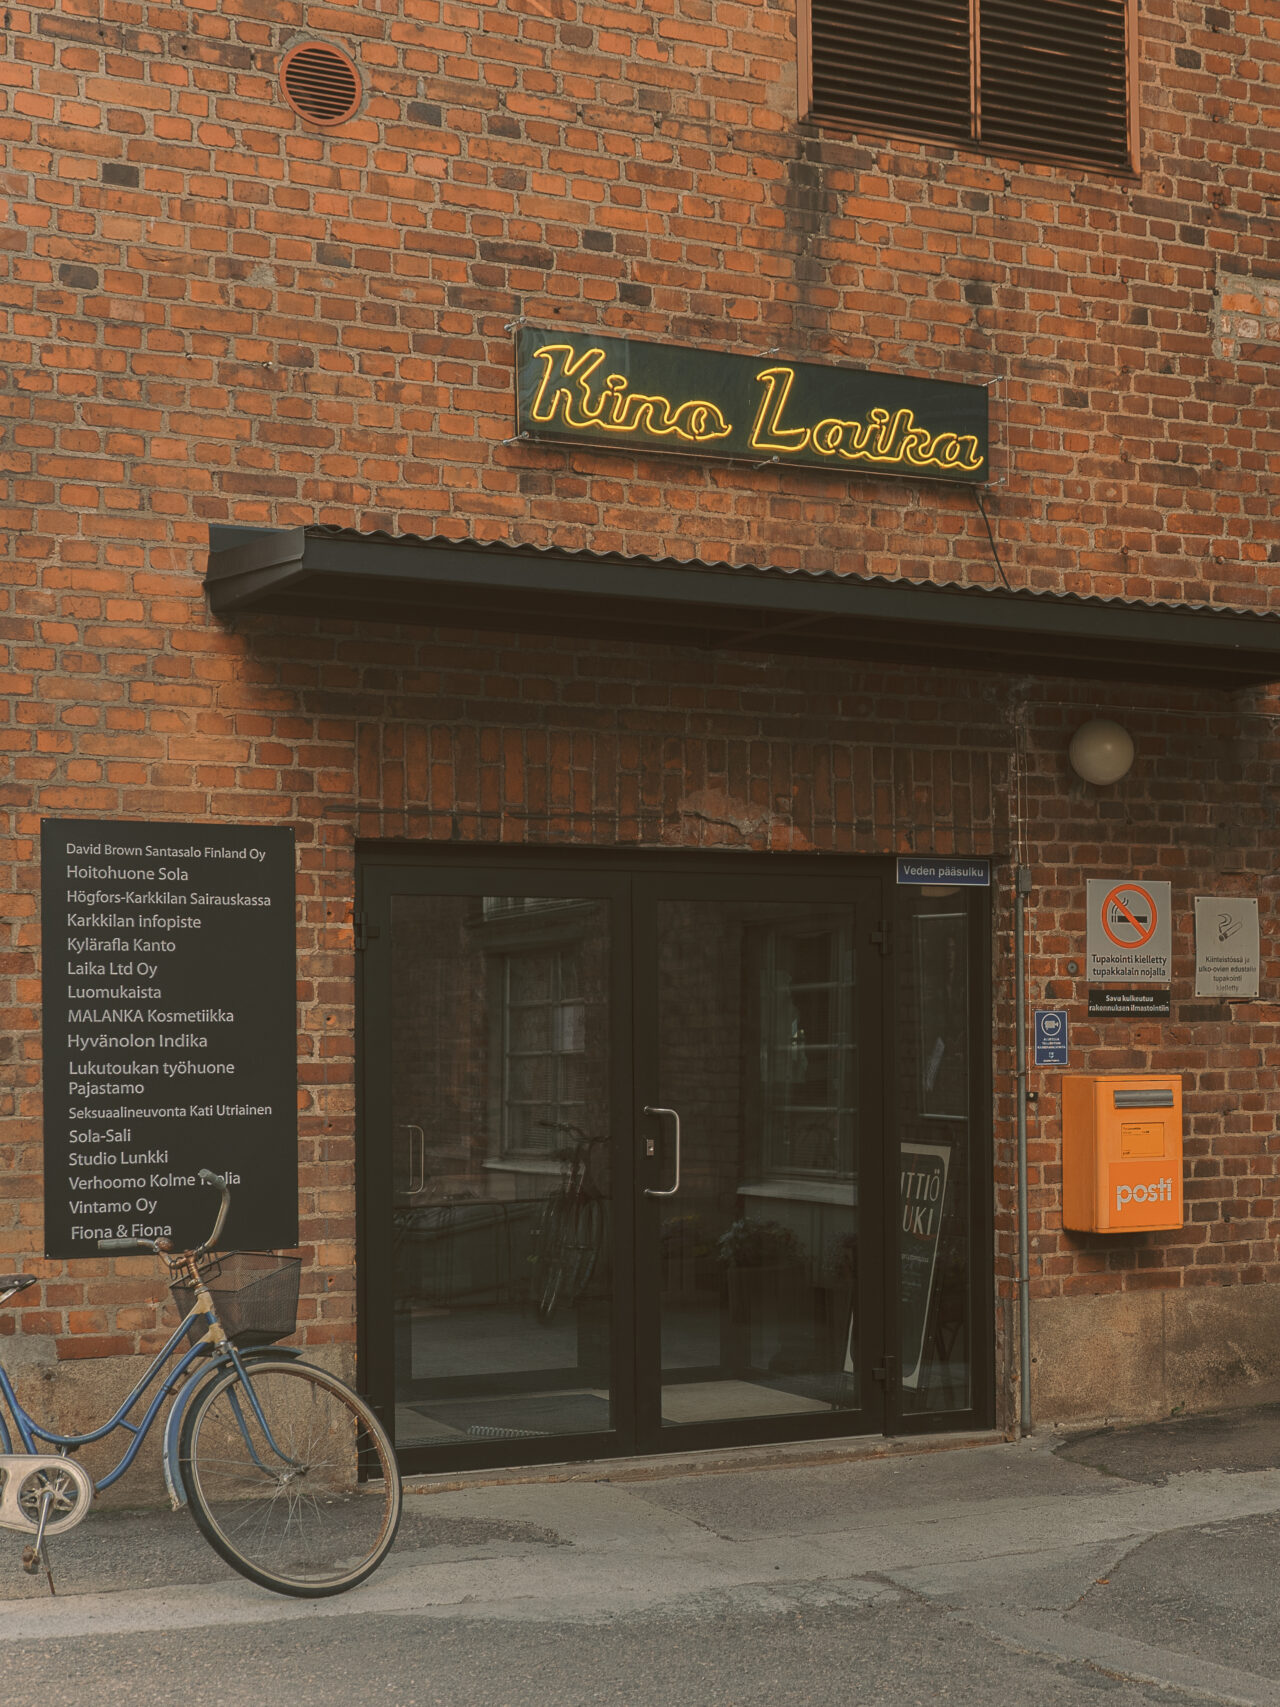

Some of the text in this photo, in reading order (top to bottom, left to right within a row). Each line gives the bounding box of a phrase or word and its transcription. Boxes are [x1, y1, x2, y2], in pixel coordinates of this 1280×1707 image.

[533, 345, 984, 471] Kino Laika
[66, 843, 266, 862] David Brown Santasalo Finland Oy
[66, 865, 189, 881] Hoitohuone Sola
[903, 865, 984, 878] Veden pääsulku
[67, 890, 271, 907] Högfors-Karkkilan Sairauskassa
[67, 913, 202, 931] Karkkilan infopiste
[67, 937, 176, 954] Kylärafla Kanto
[1091, 954, 1167, 966] Tupakointi kielletty
[68, 962, 158, 979] Laika Ltd Oy
[1092, 967, 1166, 979] tupakkalain nojalla
[68, 985, 162, 999] Luomukaista
[1105, 994, 1121, 1002] Savu
[68, 1009, 234, 1023] MALANKA Kosmetiikka
[1088, 1004, 1169, 1012] rakennuksen ilmastointiin
[67, 1034, 208, 1051] Hyvänolon Indika
[69, 1060, 235, 1077] Lukutoukan työhuone
[68, 1081, 145, 1098] Pajastamo
[68, 1104, 272, 1119] Seksuaalineuvonta Kati Utriainen
[69, 1128, 132, 1143] Sola-Sali
[68, 1150, 169, 1166] Studio Lunkki
[68, 1175, 146, 1190] Verhoomo
[150, 1173, 195, 1187] Kolme
[900, 1168, 940, 1202] ITTIÖ
[1116, 1177, 1172, 1211] posti
[69, 1198, 158, 1214] Vintamo Oy
[902, 1204, 934, 1236] UKI
[71, 1223, 172, 1240] Fiona & Fiona
